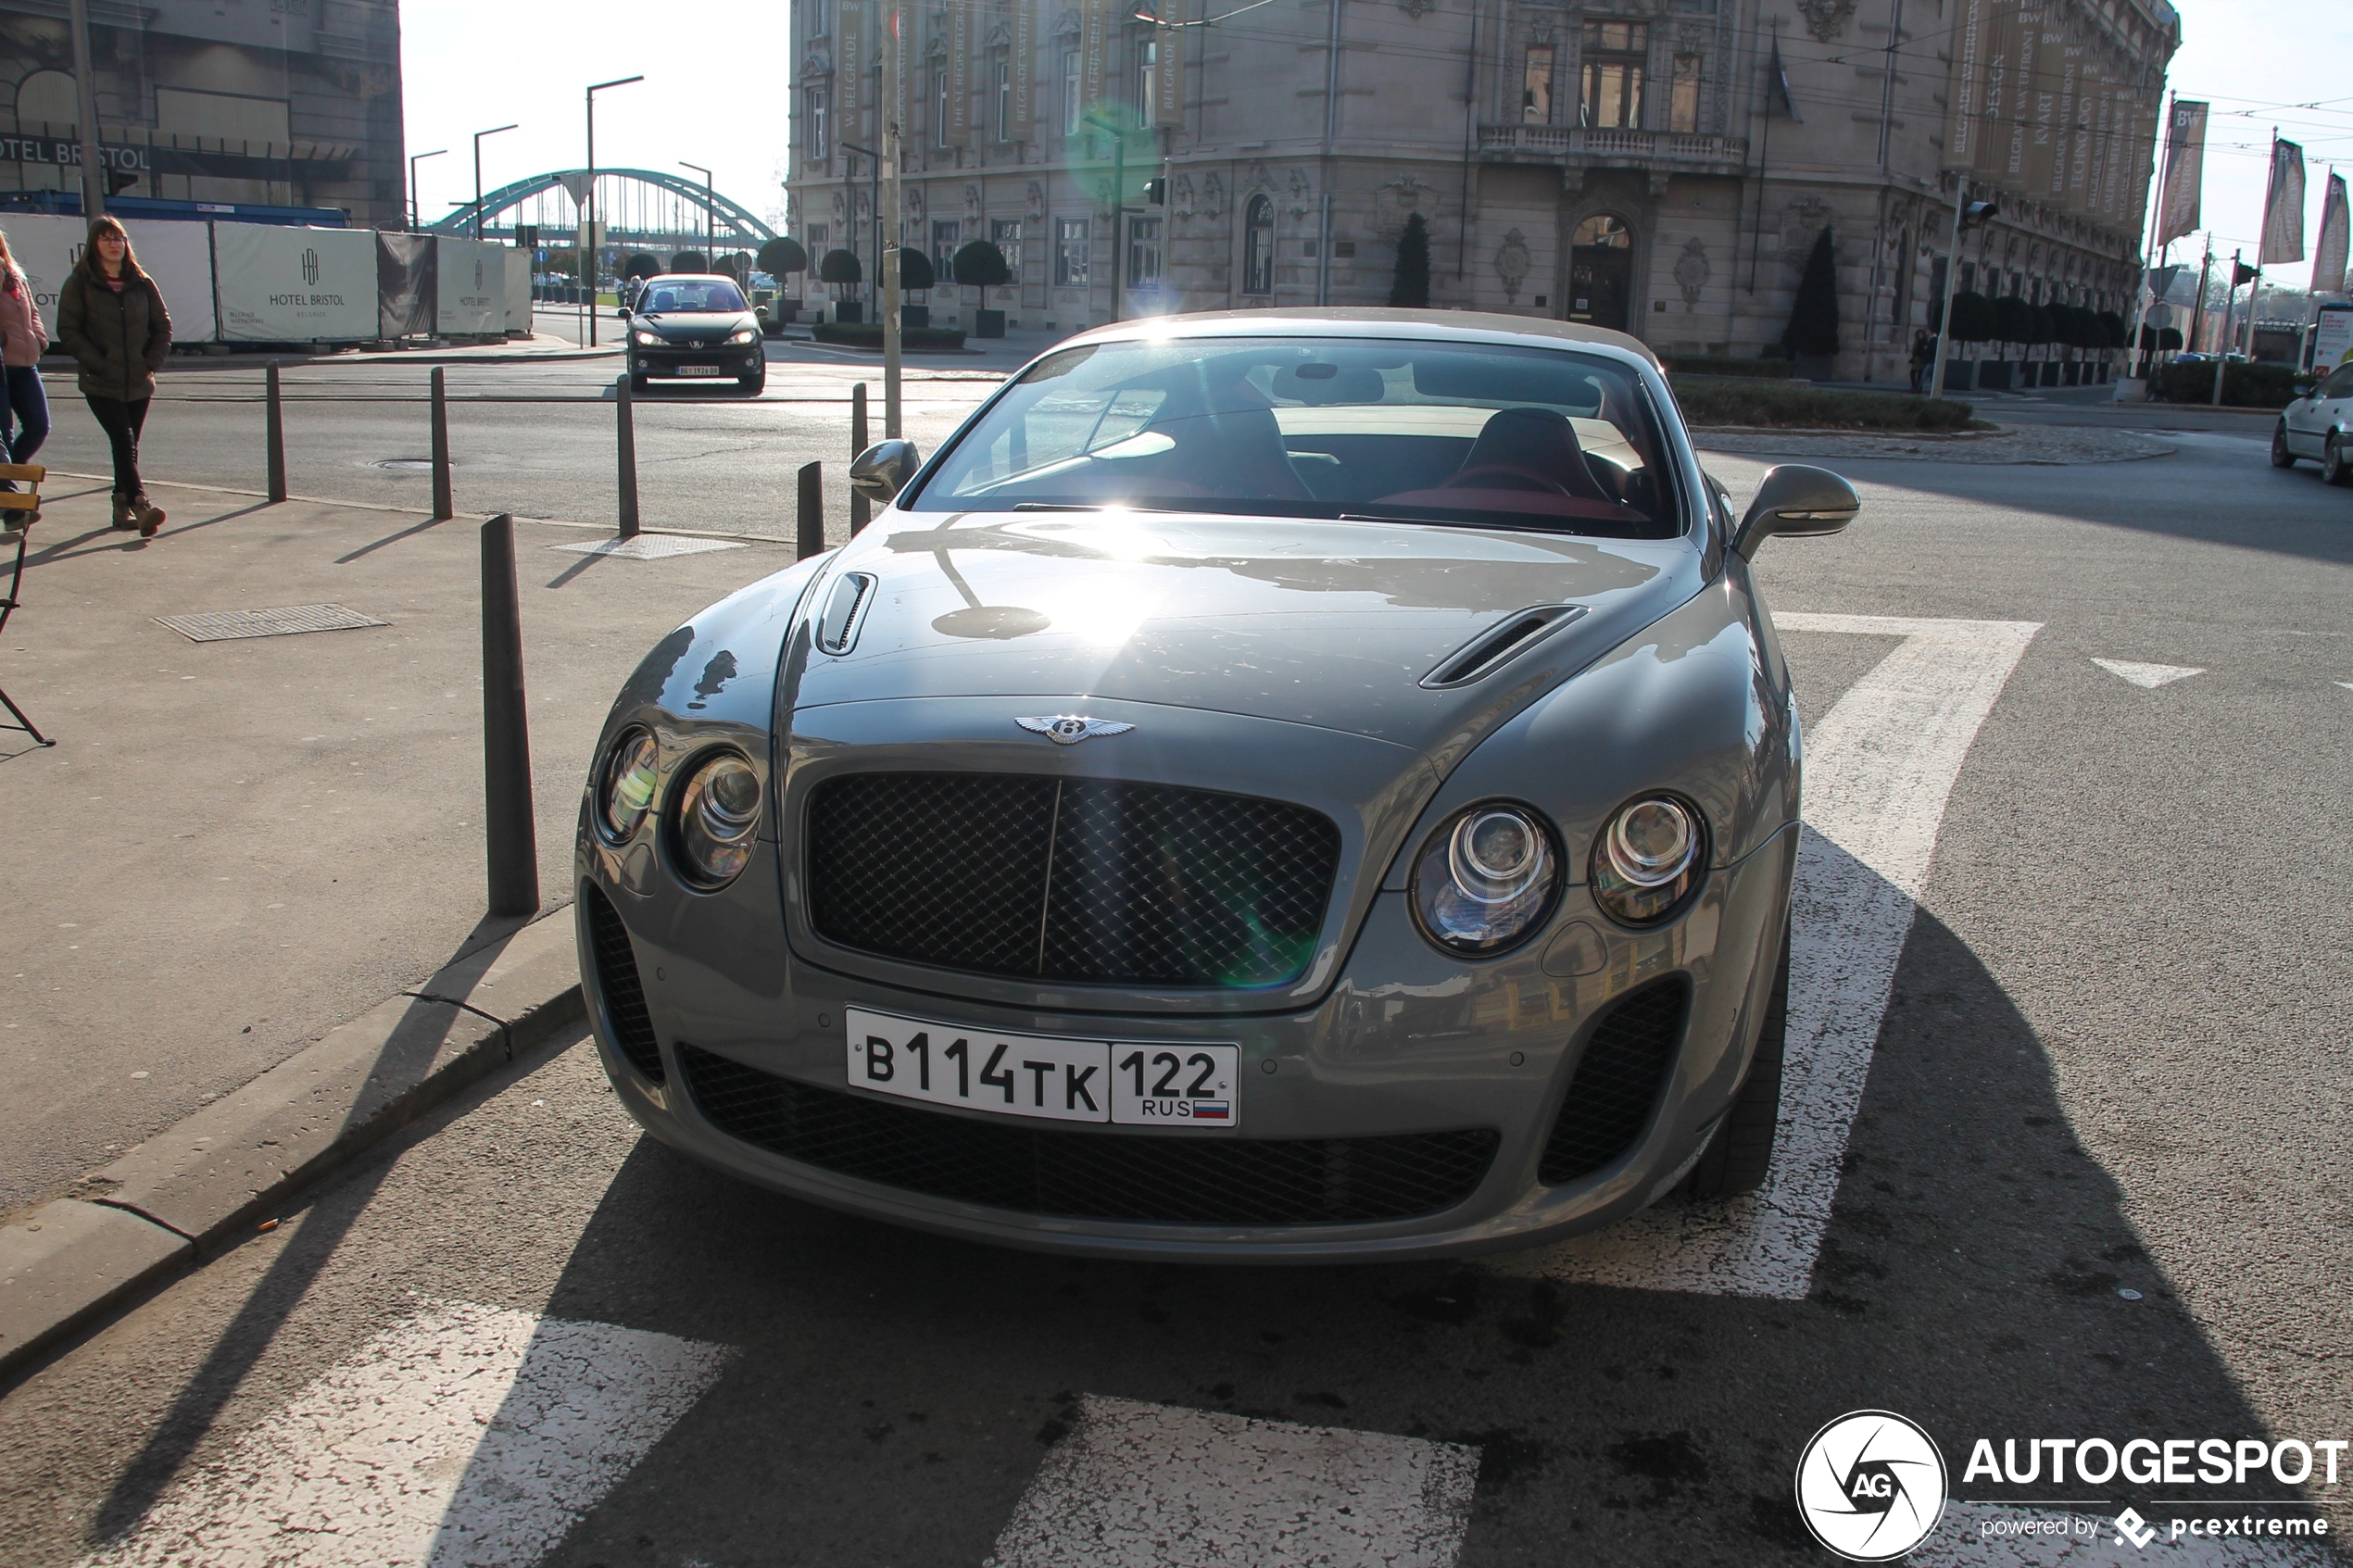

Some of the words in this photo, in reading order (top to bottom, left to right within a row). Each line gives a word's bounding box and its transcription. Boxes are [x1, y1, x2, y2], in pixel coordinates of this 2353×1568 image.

[842, 1, 860, 11] BW
[2019, 12, 2043, 23] BW
[2043, 33, 2064, 44] BW
[844, 31, 857, 109] BELGRADE
[954, 53, 965, 85] REGIS
[1016, 59, 1027, 121] BELGRADE
[1088, 47, 1101, 112] GALERIJA
[1163, 41, 1176, 109] BELGRADE
[1985, 54, 2006, 119] DESIGN
[844, 115, 856, 128] W
[953, 107, 963, 128] THE
[2034, 92, 2053, 144] KVART
[2057, 61, 2076, 135] WATERFRONT
[2177, 110, 2204, 128] BW
[2052, 138, 2068, 192] BELGRADE
[2087, 158, 2103, 208] BELGRADE
[2102, 166, 2119, 213] GALERIJA
[270, 295, 308, 306] HOTEL
[310, 295, 346, 306] BRISTOL
[1119, 1050, 1216, 1098] 122
[1141, 1099, 1191, 1117] RUS
